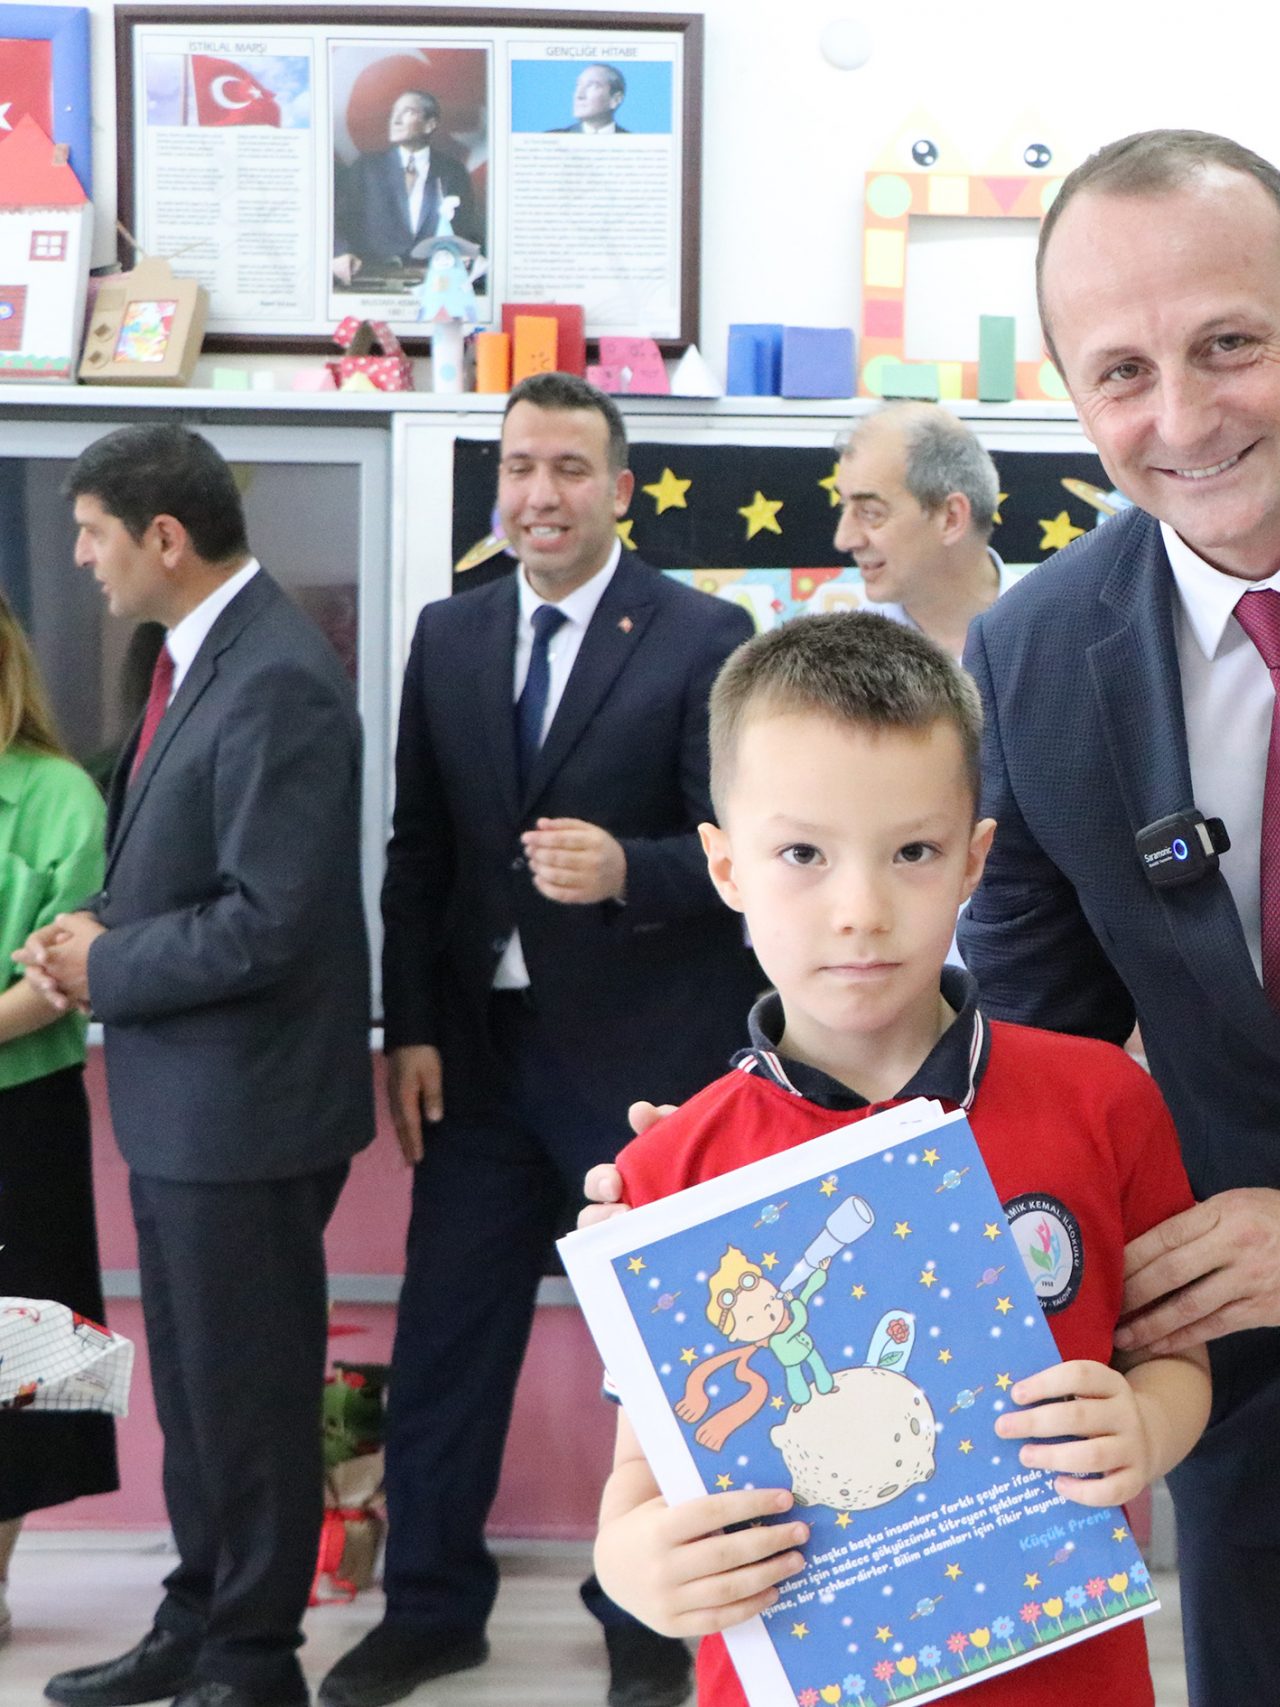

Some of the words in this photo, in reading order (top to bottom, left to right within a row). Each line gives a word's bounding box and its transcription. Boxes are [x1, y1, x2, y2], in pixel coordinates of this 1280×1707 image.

[1144, 845, 1173, 864] Saramonic
[1028, 1200, 1062, 1218] KEMAL
[778, 1578, 809, 1595] zıları
[808, 1568, 831, 1585] için
[831, 1553, 870, 1576] sadece
[871, 1525, 938, 1562] gökyüzünde
[937, 1508, 988, 1534] titreyen
[988, 1485, 1045, 1515] ışıklardır.
[812, 1546, 849, 1566] başka
[849, 1532, 885, 1553] başka
[885, 1510, 940, 1538] insanlara
[940, 1498, 975, 1517] farklı
[976, 1480, 1011, 1503] şeyler
[1012, 1468, 1043, 1488] ifade
[1018, 1525, 1066, 1552] Küçük
[1067, 1508, 1113, 1534] Prens
[796, 1590, 816, 1604] bir
[817, 1563, 894, 1597] rehberdirler.
[892, 1550, 922, 1568] Bilim
[922, 1528, 973, 1557] adamları
[973, 1521, 995, 1539] için
[995, 1508, 1023, 1528] fikir
